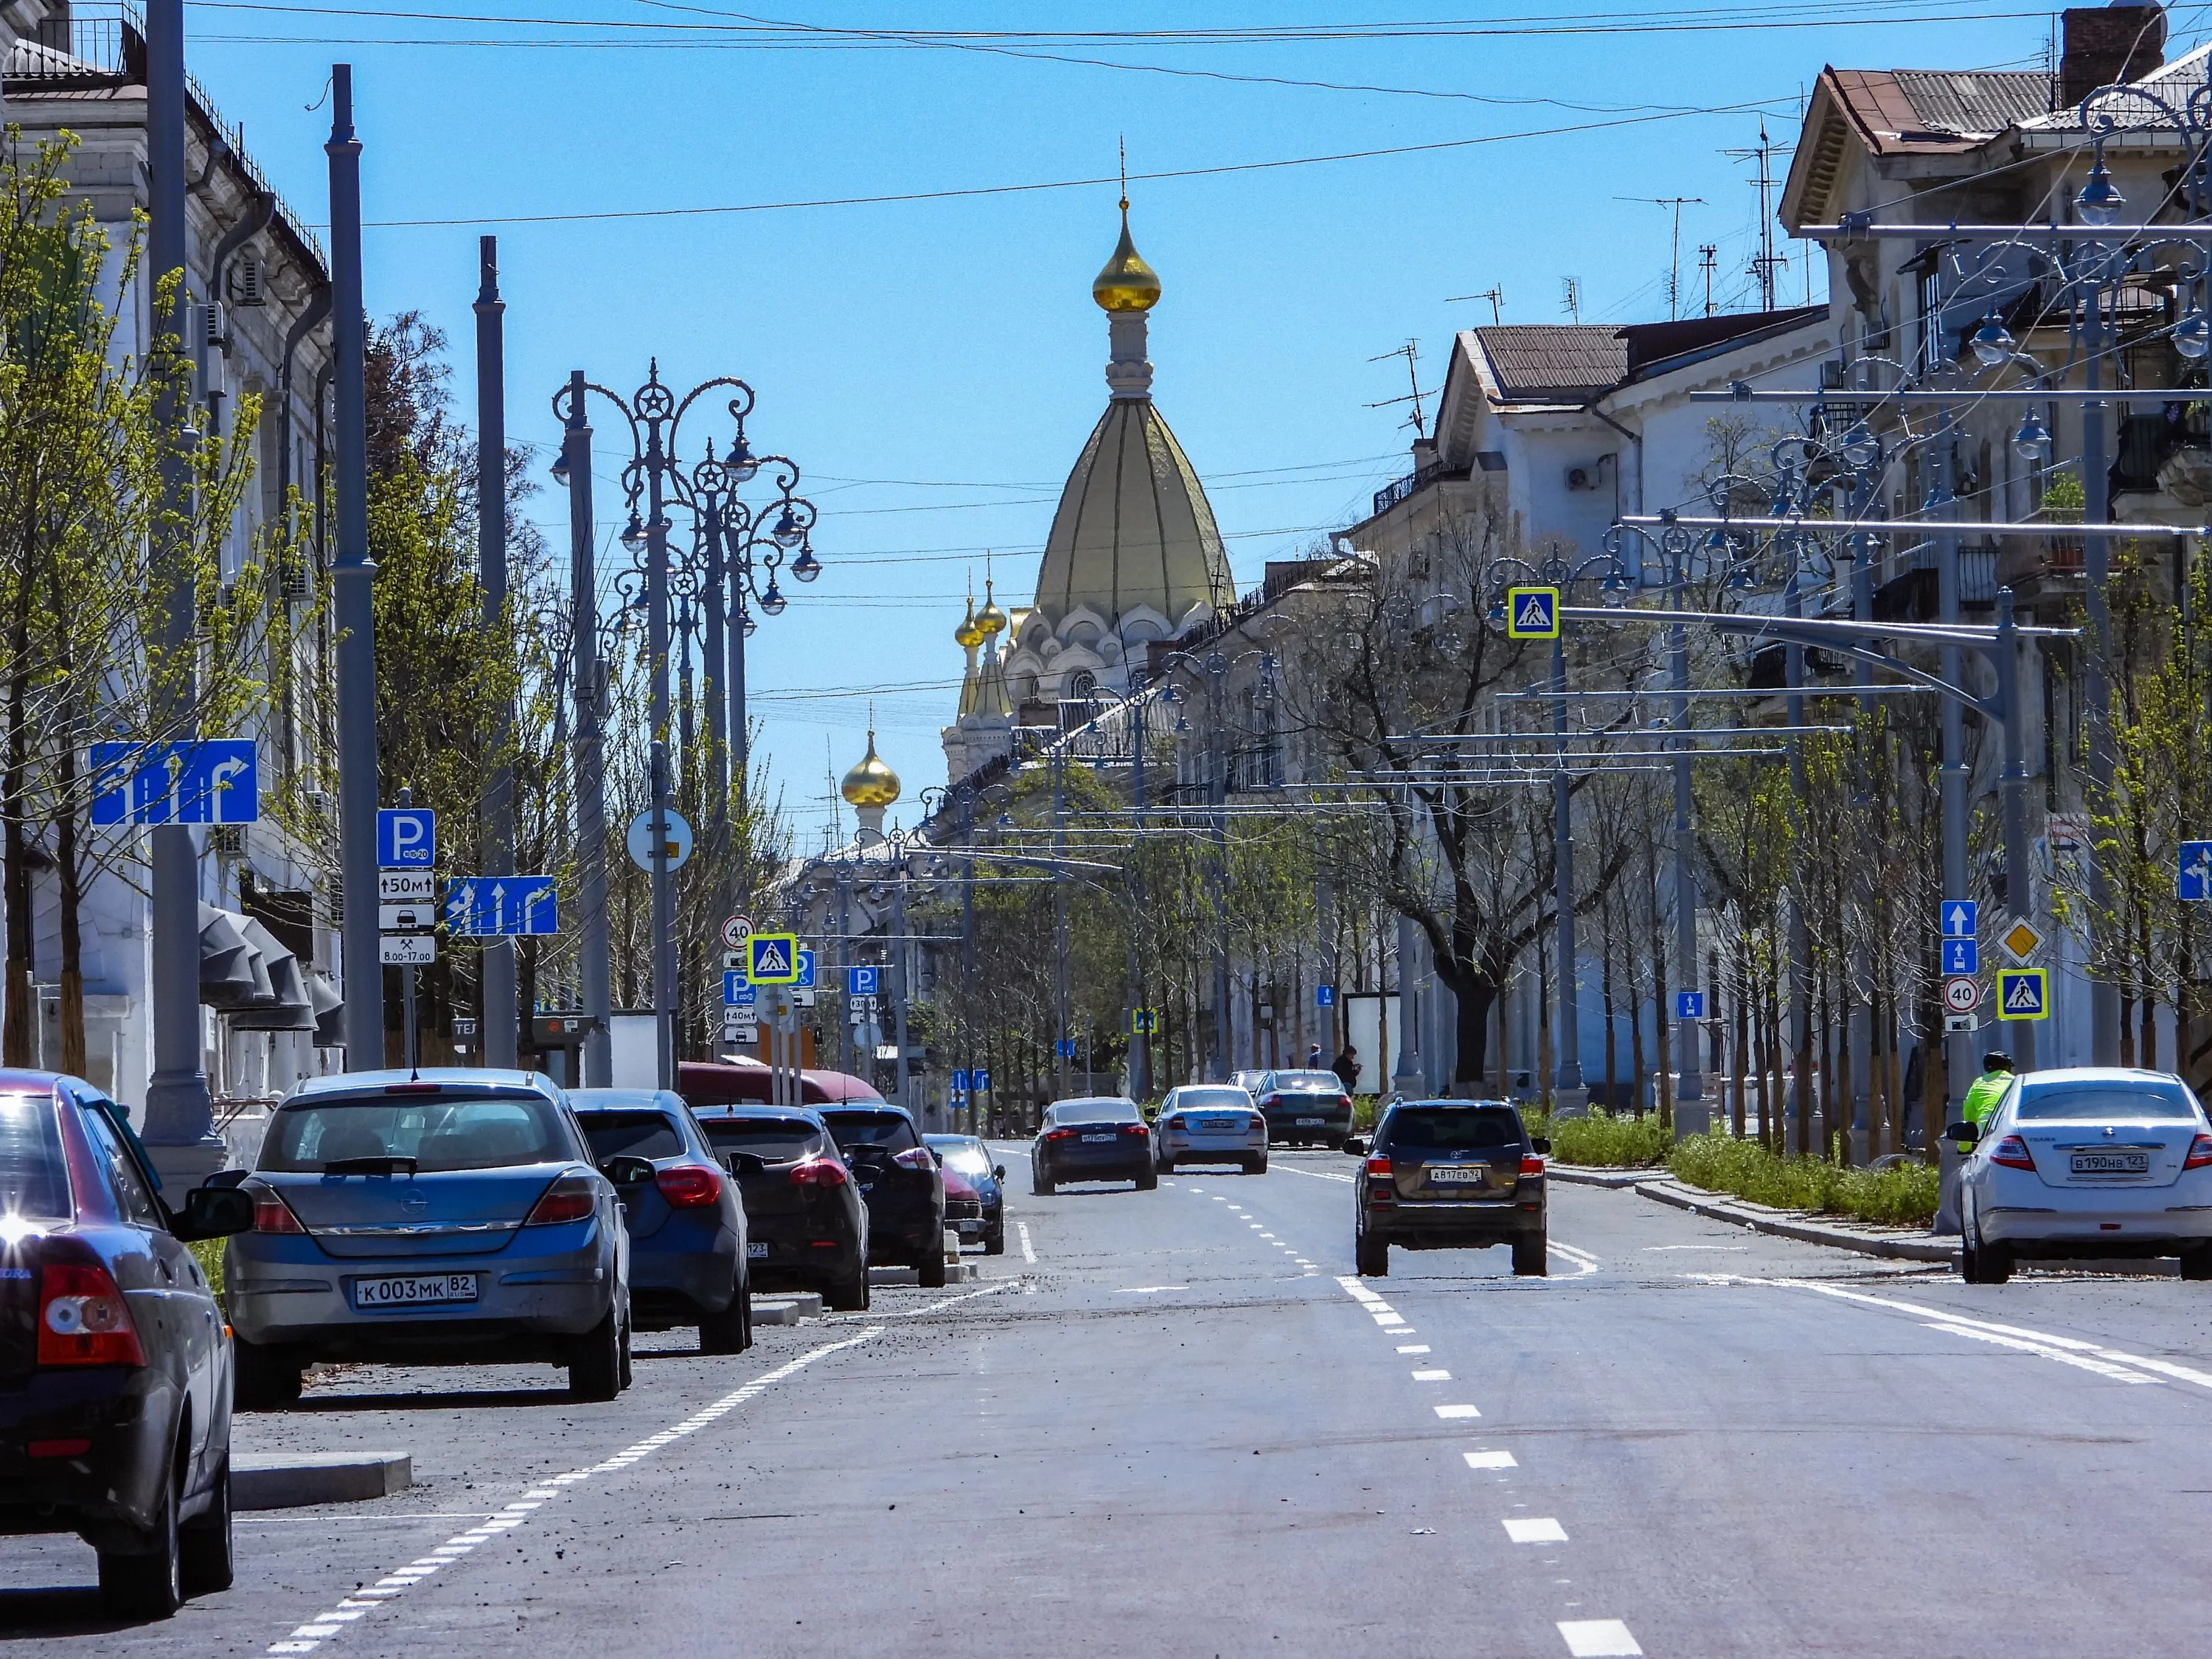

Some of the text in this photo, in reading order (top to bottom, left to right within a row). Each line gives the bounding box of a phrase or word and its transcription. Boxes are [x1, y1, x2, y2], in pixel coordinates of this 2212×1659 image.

[393, 816, 423, 860] P
[418, 850, 428, 858] 20
[729, 926, 748, 939] 40
[384, 951, 431, 961] 8.00-17.00
[858, 970, 872, 992] P
[733, 975, 751, 1001] P
[1952, 988, 1972, 1001] 40
[2126, 1155, 2145, 1166] 123
[748, 1244, 765, 1253] 123
[364, 1276, 470, 1301] К003МК 82
